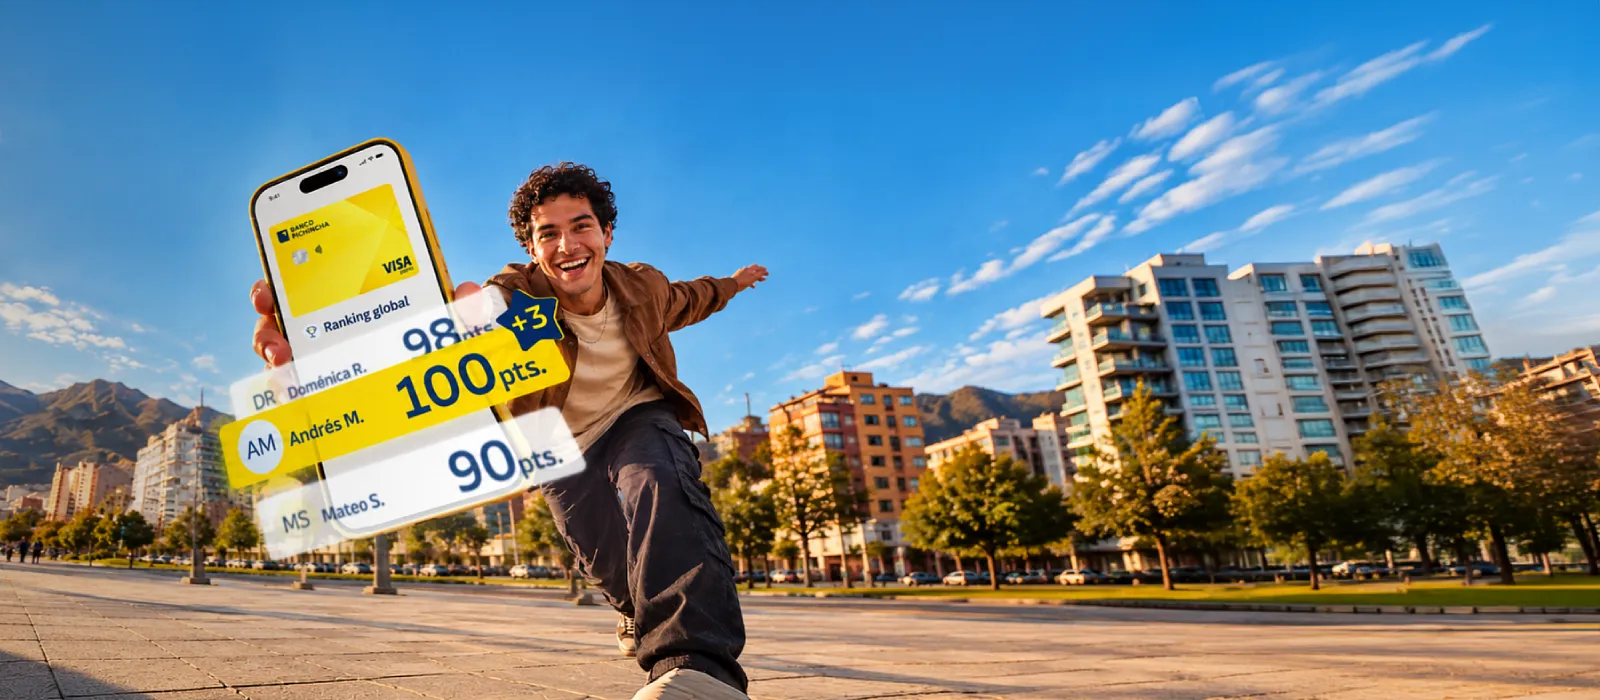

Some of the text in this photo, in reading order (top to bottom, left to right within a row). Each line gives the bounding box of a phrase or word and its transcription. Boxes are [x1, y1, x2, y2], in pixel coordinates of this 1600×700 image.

[381, 255, 412, 274] VISA
[323, 295, 410, 332] Ranking global
[511, 304, 548, 331] +3
[247, 353, 547, 460] AM Andrés M. 100 pts.
[252, 389, 276, 411] DR
[287, 368, 351, 400] Doménica
[351, 362, 367, 377] R.
[282, 439, 564, 533] MS Mateo S. 90 pts.
